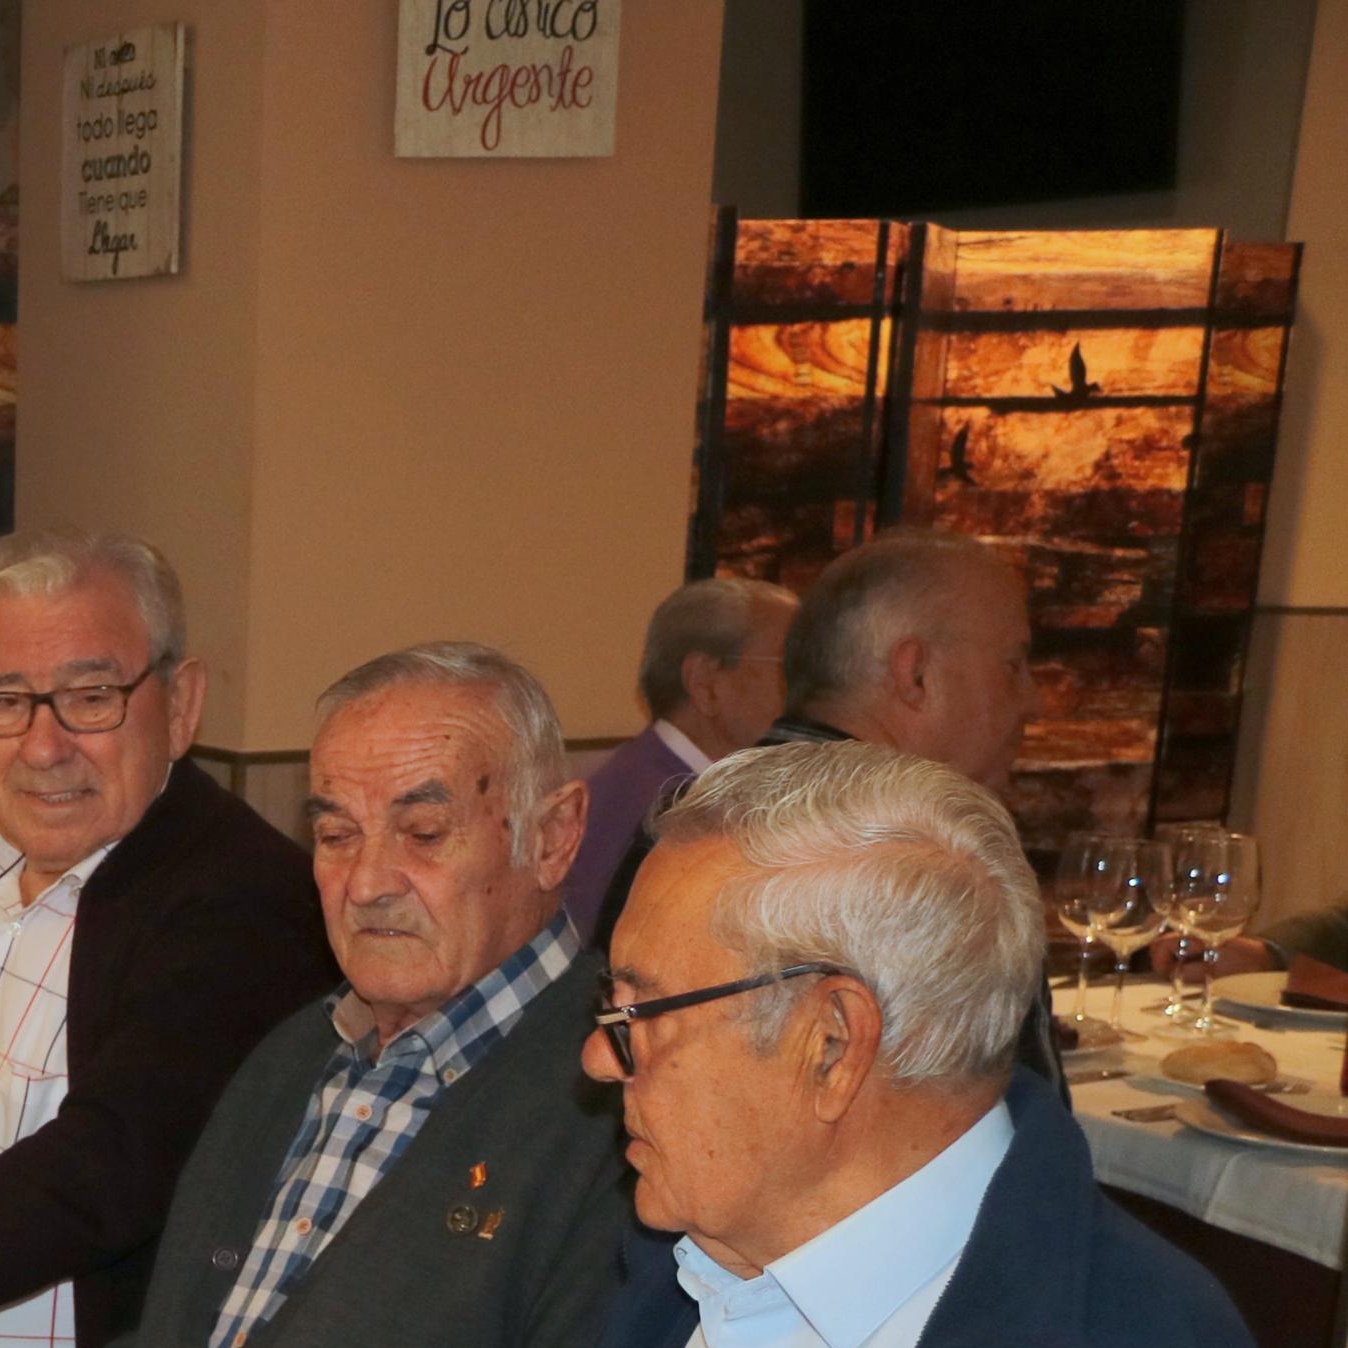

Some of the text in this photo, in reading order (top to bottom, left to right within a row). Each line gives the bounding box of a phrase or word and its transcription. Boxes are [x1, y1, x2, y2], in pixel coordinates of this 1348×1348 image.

[422, 45, 594, 151] Urgente
[77, 110, 158, 144] todo llega
[81, 144, 152, 182] cuando
[120, 190, 146, 215] que
